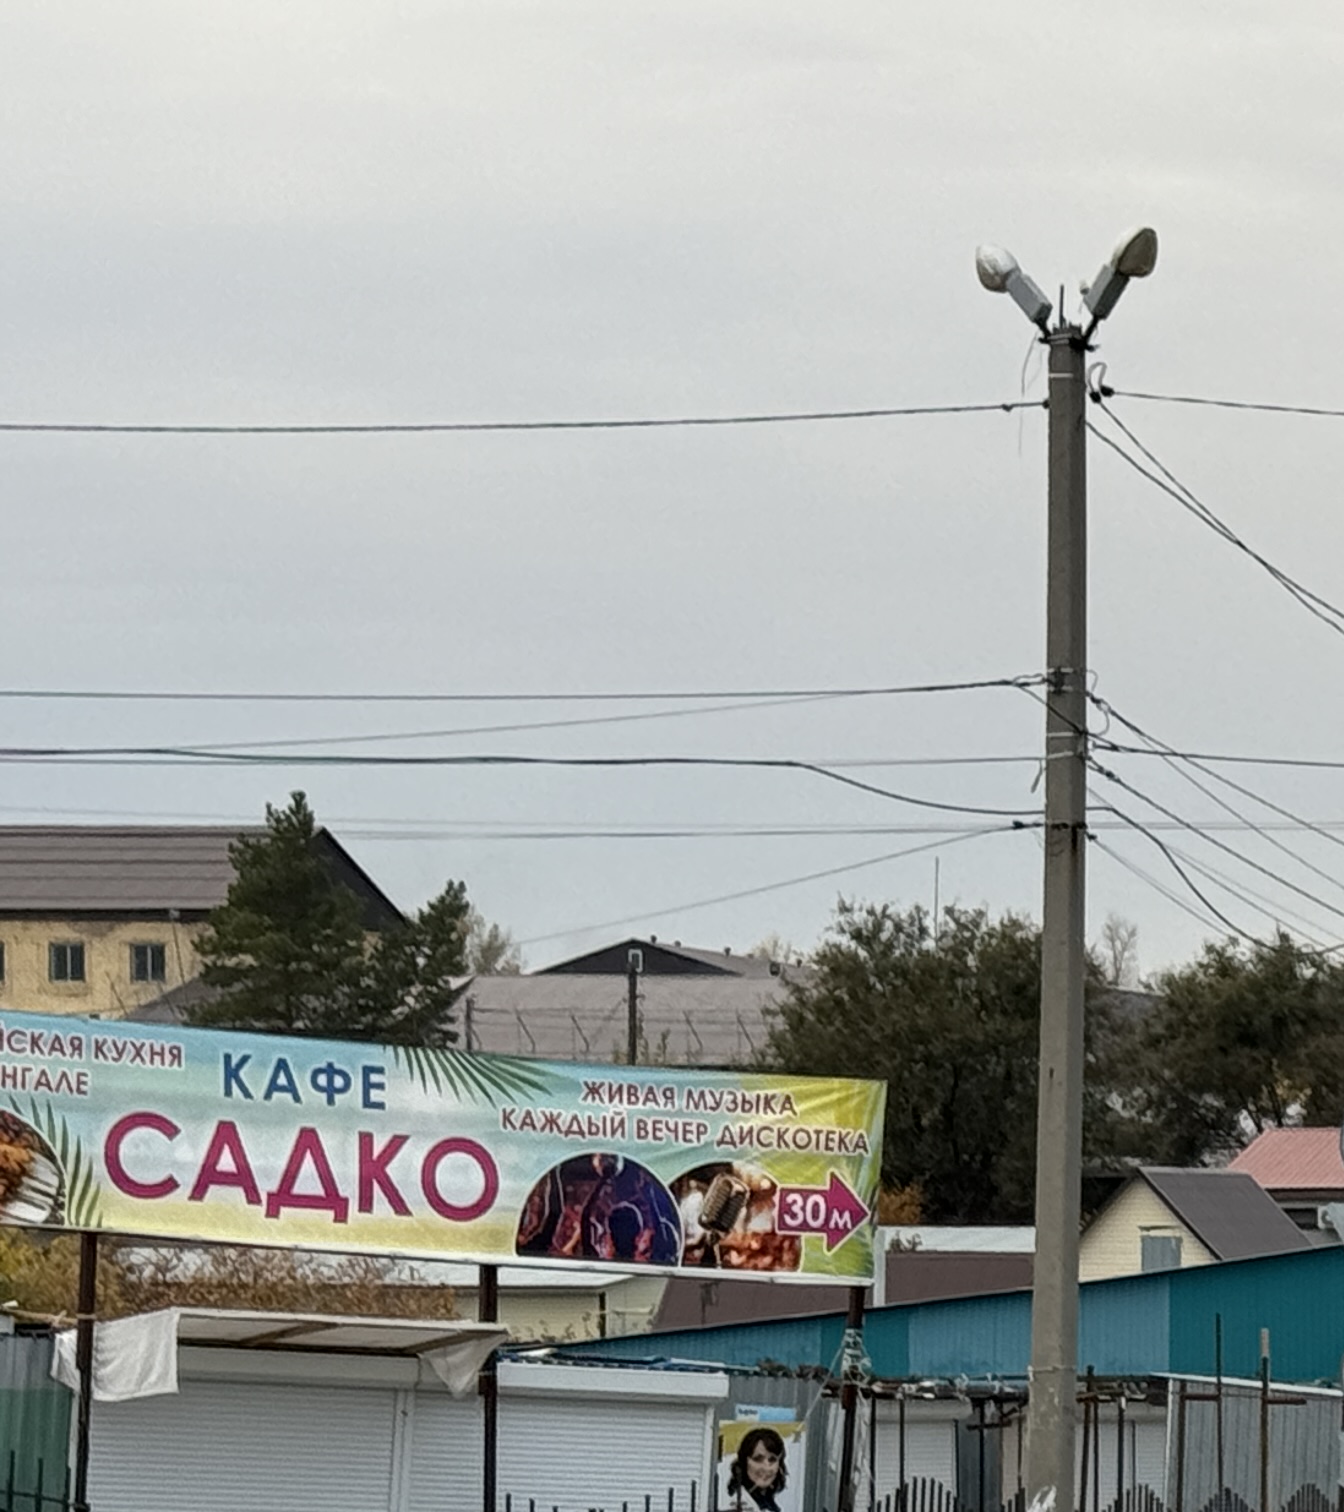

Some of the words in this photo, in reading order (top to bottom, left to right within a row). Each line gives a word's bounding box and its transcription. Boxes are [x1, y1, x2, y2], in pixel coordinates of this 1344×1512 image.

[94, 1037, 183, 1068] КУХНЯ
[1, 1064, 89, 1096] НГАЛЕ
[222, 1052, 387, 1111] КАФЕ
[581, 1080, 676, 1109] ЖИВАЯ
[686, 1087, 798, 1116] МУЗЫКА
[501, 1107, 626, 1140] КАЖДЫЙ
[636, 1116, 708, 1145] ВЕЧЕР
[716, 1124, 870, 1154] ДИСКОТЕКА
[103, 1110, 499, 1224] САДКО
